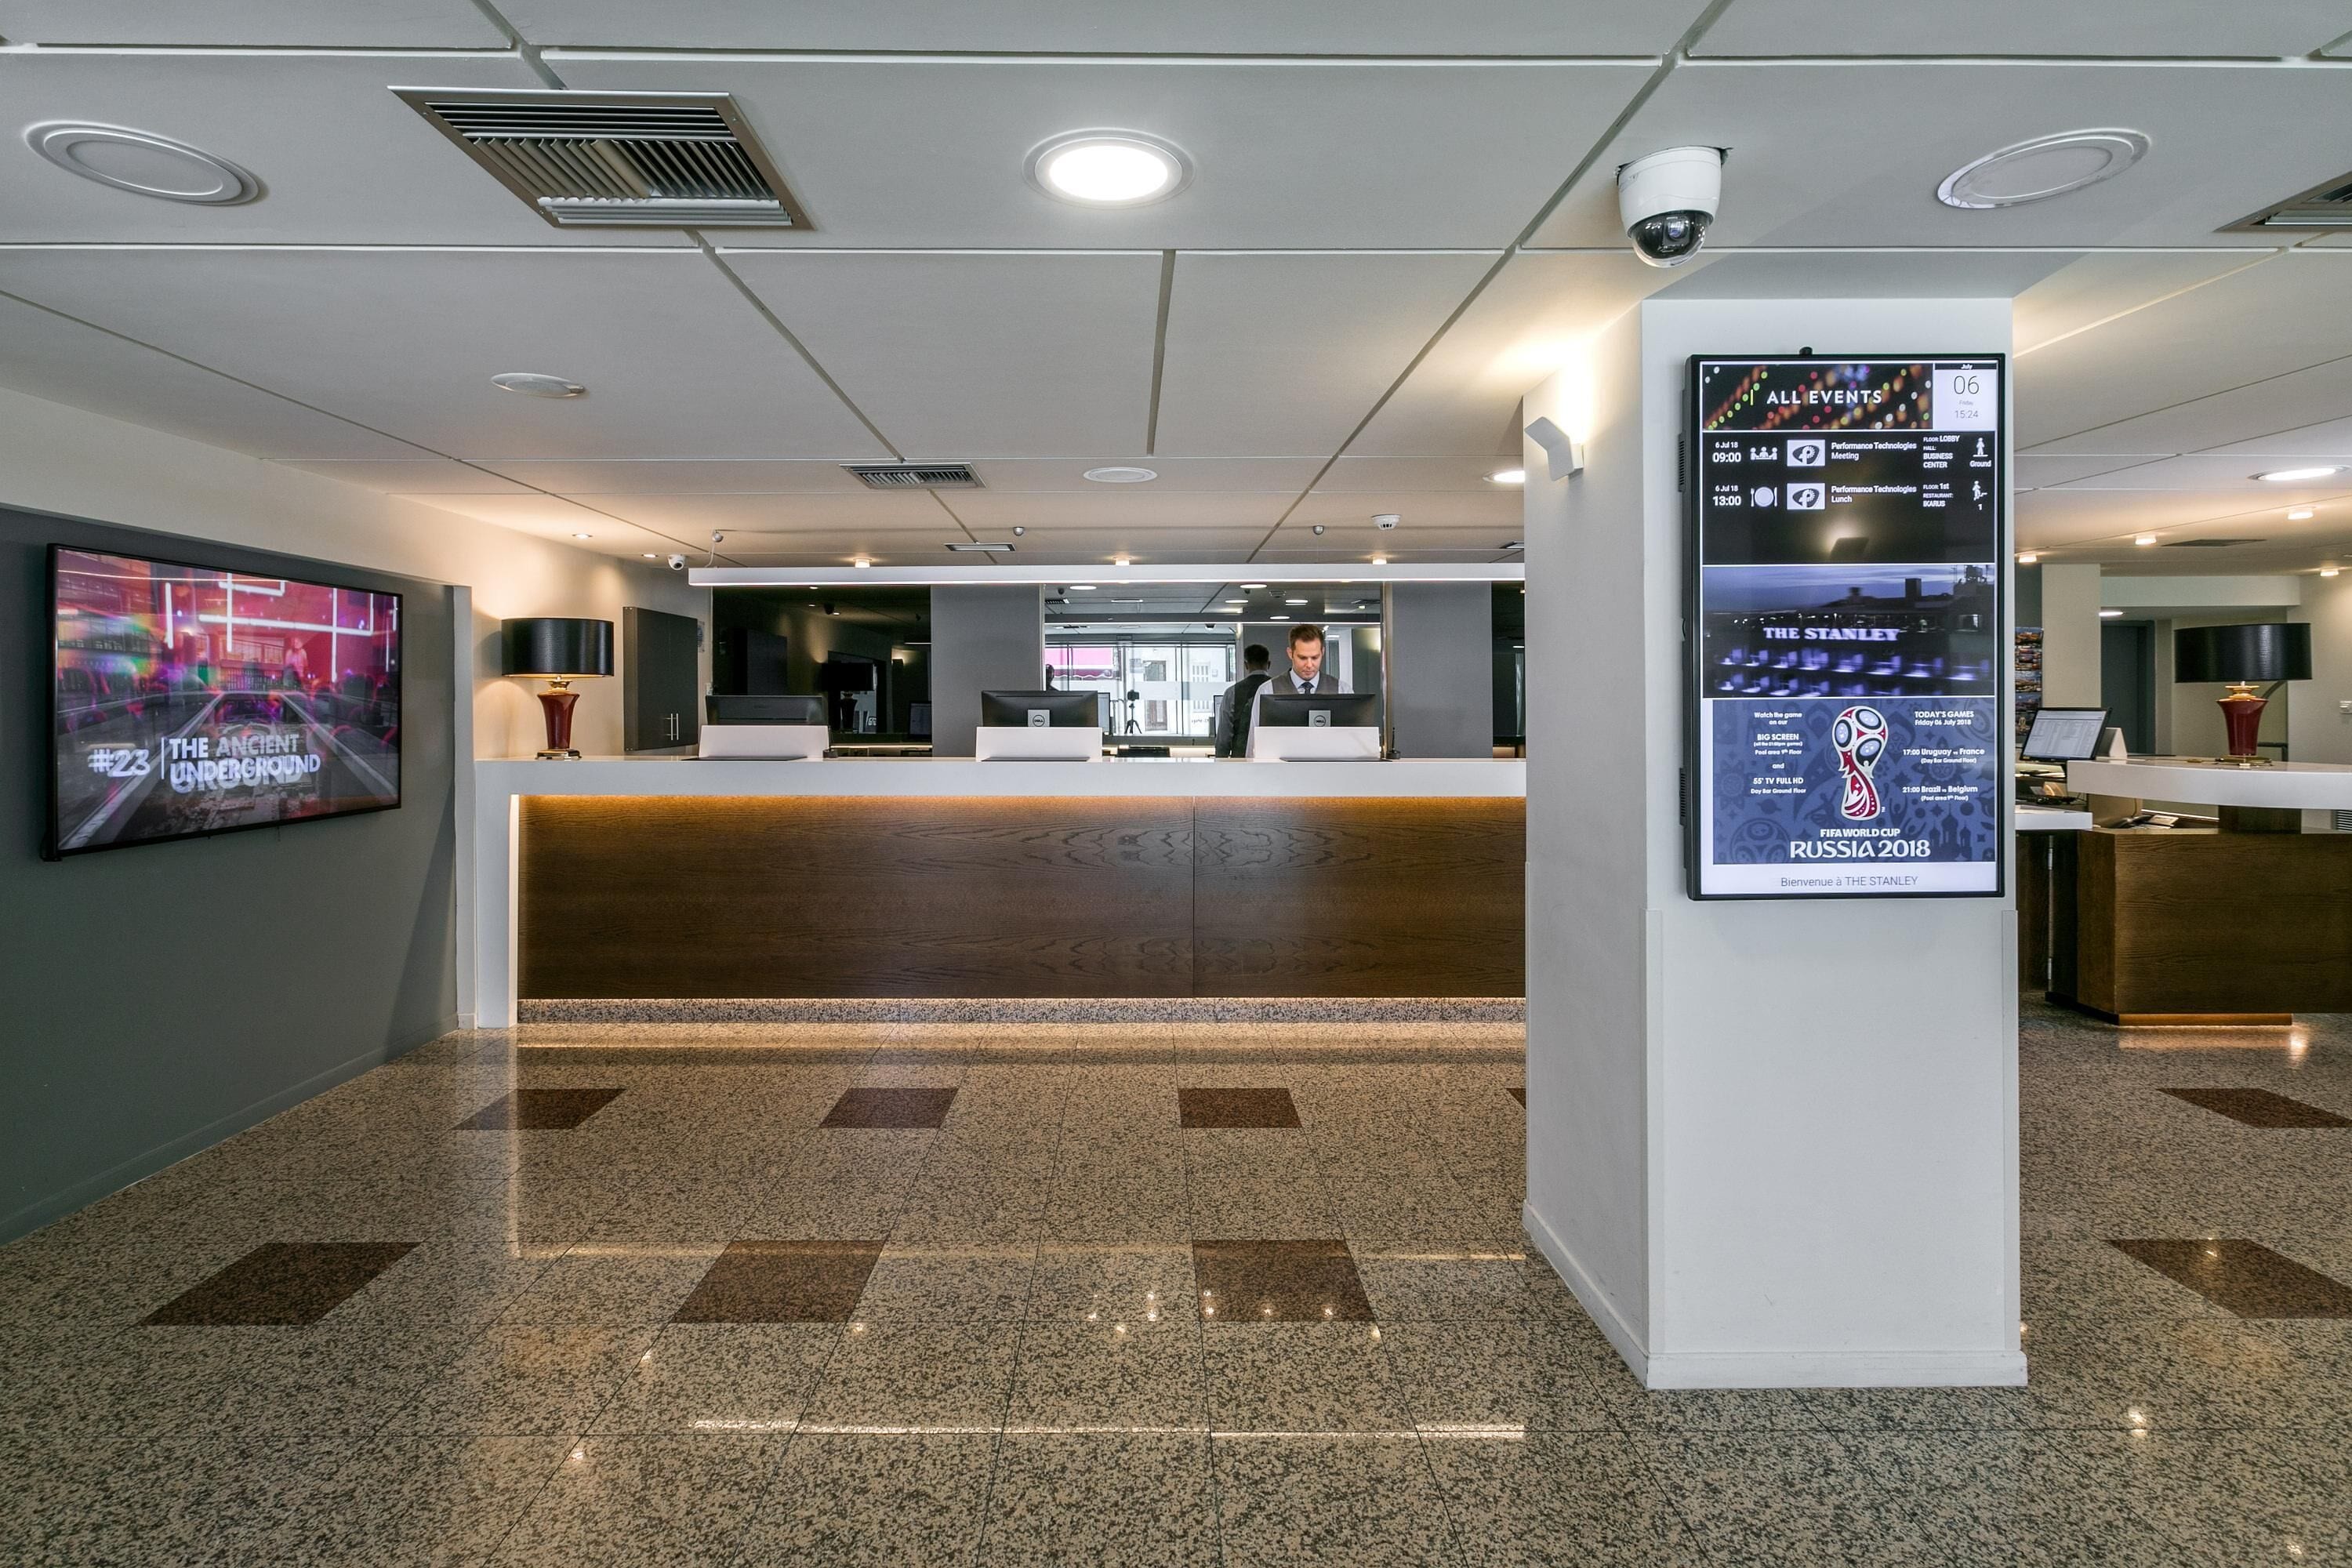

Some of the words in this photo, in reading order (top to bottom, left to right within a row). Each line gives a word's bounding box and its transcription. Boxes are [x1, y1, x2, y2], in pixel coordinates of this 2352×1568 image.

[1954, 376, 1979, 394] 06
[1766, 390, 1801, 404] ALL
[1809, 390, 1882, 404] EVENTS
[1955, 410, 1979, 419] 15:24
[1712, 452, 1741, 463] 09:00
[1831, 452, 1860, 460] Meeting
[1712, 495, 1741, 506] 13:00
[1763, 627, 1800, 639] THE
[1804, 629, 1900, 641] STANLEY
[169, 737, 209, 759] THE
[216, 734, 299, 757] ANCIENT
[169, 754, 321, 784] UNDERGROUND
[1820, 829, 1842, 837] FIFA
[1880, 828, 1900, 837] CUP
[1790, 840, 1876, 858] RUSSIA
[1877, 840, 1931, 857] 2018
[1780, 877, 1833, 887] Bienvenue
[1836, 877, 1842, 886] à
[1845, 877, 1867, 886] THE
[1869, 876, 1918, 886] STANLEY
